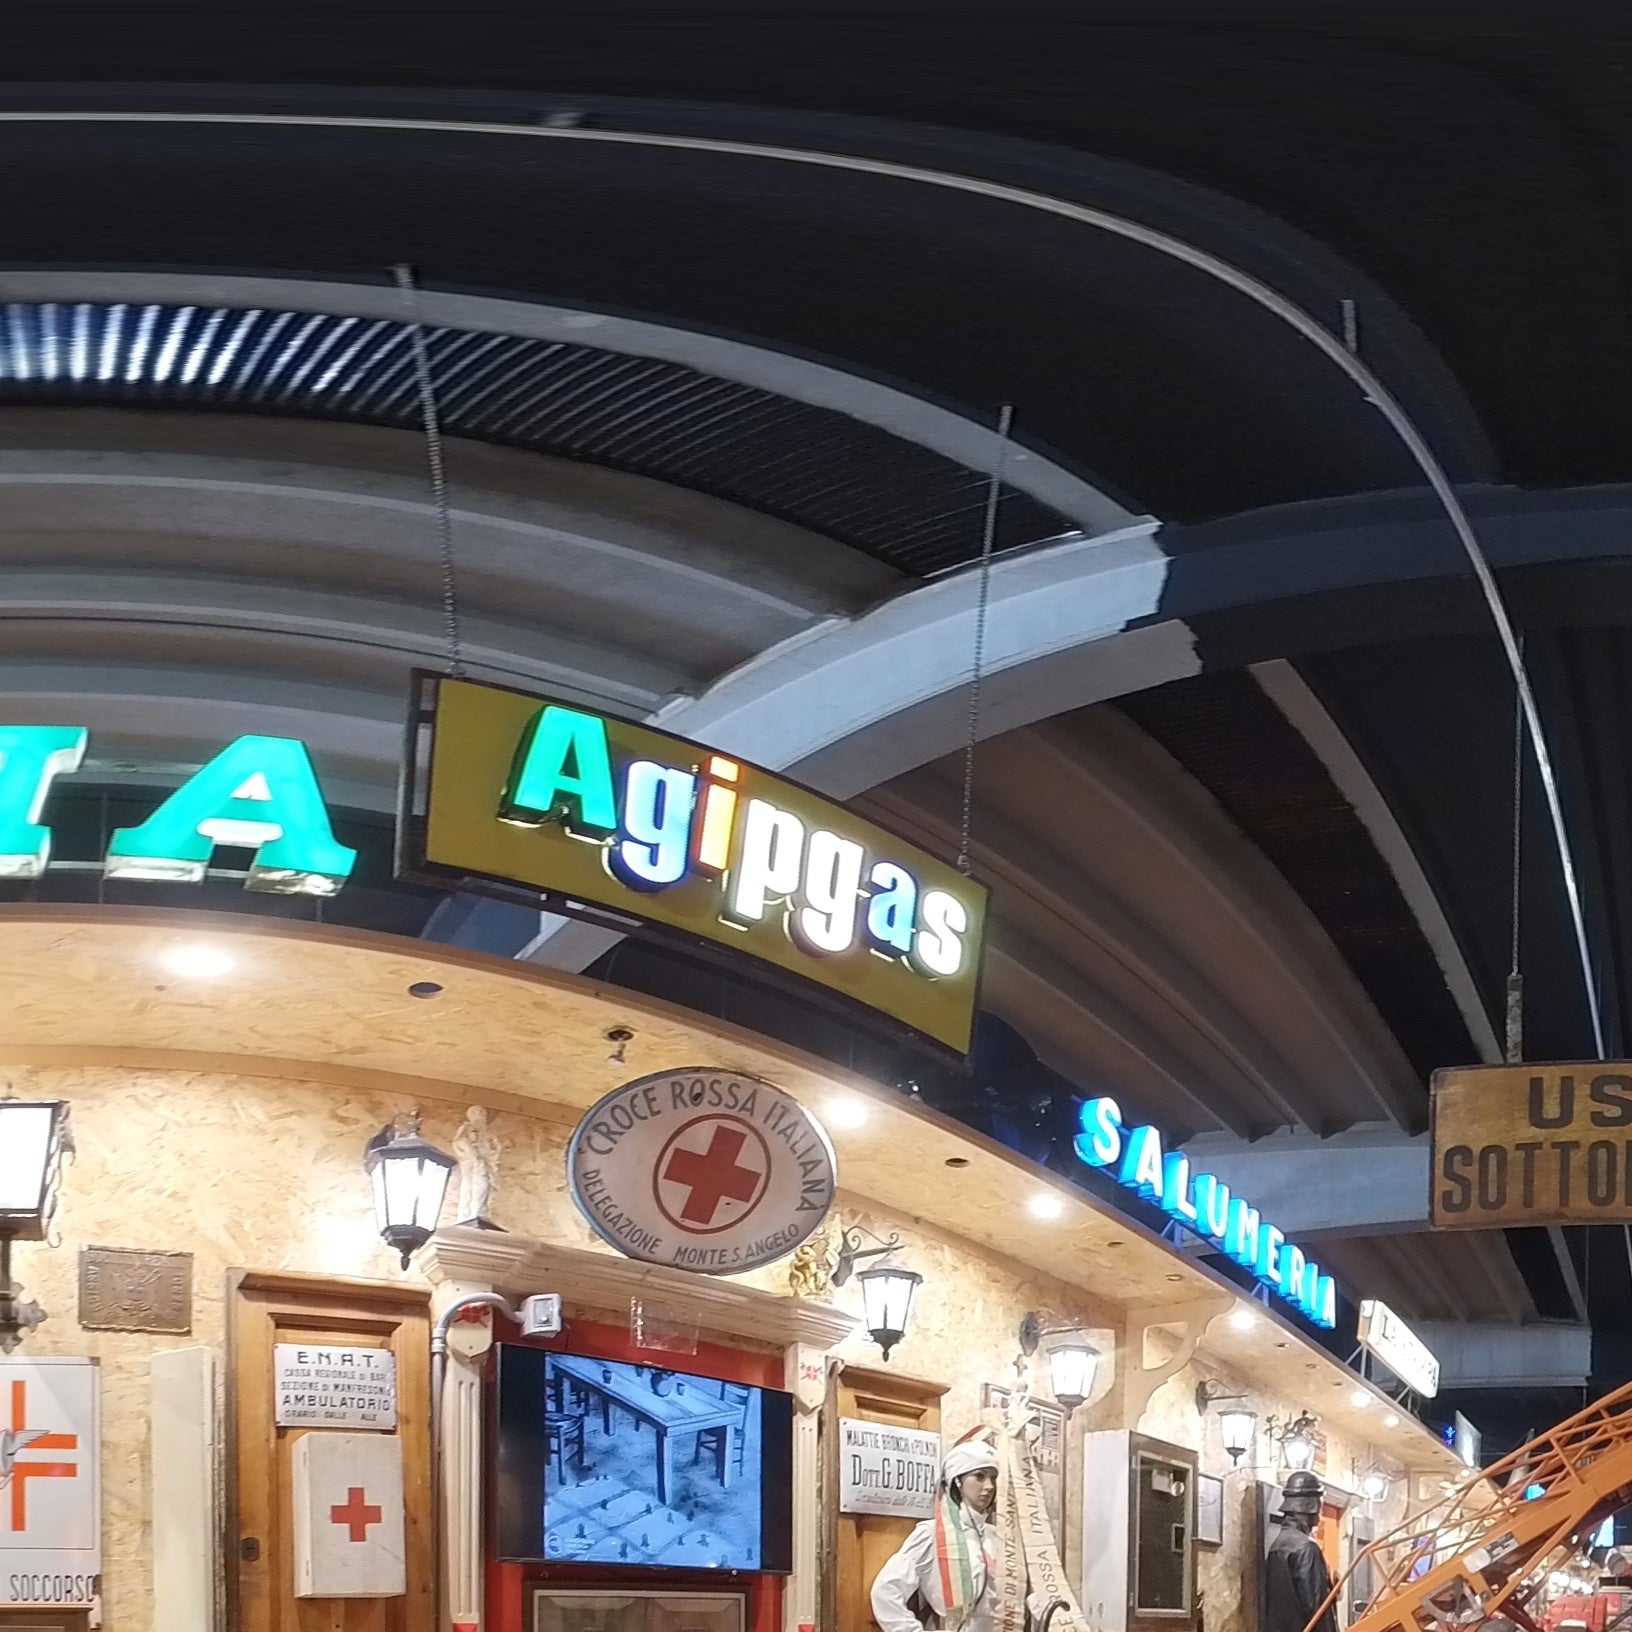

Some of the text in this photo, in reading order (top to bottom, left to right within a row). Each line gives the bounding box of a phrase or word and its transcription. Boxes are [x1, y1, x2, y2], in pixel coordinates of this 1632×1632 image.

[500, 704, 968, 981] Agipgas
[586, 1078, 829, 1213] CROCE ROSSA ITALIANA
[1441, 1139, 1632, 1214] SOTTO
[582, 1168, 664, 1256] DELEGAZIONE
[673, 1245, 728, 1265] MONTE
[1073, 1096, 1336, 1330] SALUMERIA
[297, 1351, 379, 1368] E.N.A.T.
[283, 1394, 391, 1411] AMBULATORIO
[896, 1459, 936, 1494] BOFFA
[1004, 1536, 1018, 1580] MONTE
[10, 1574, 95, 1602] SOCCORSO
